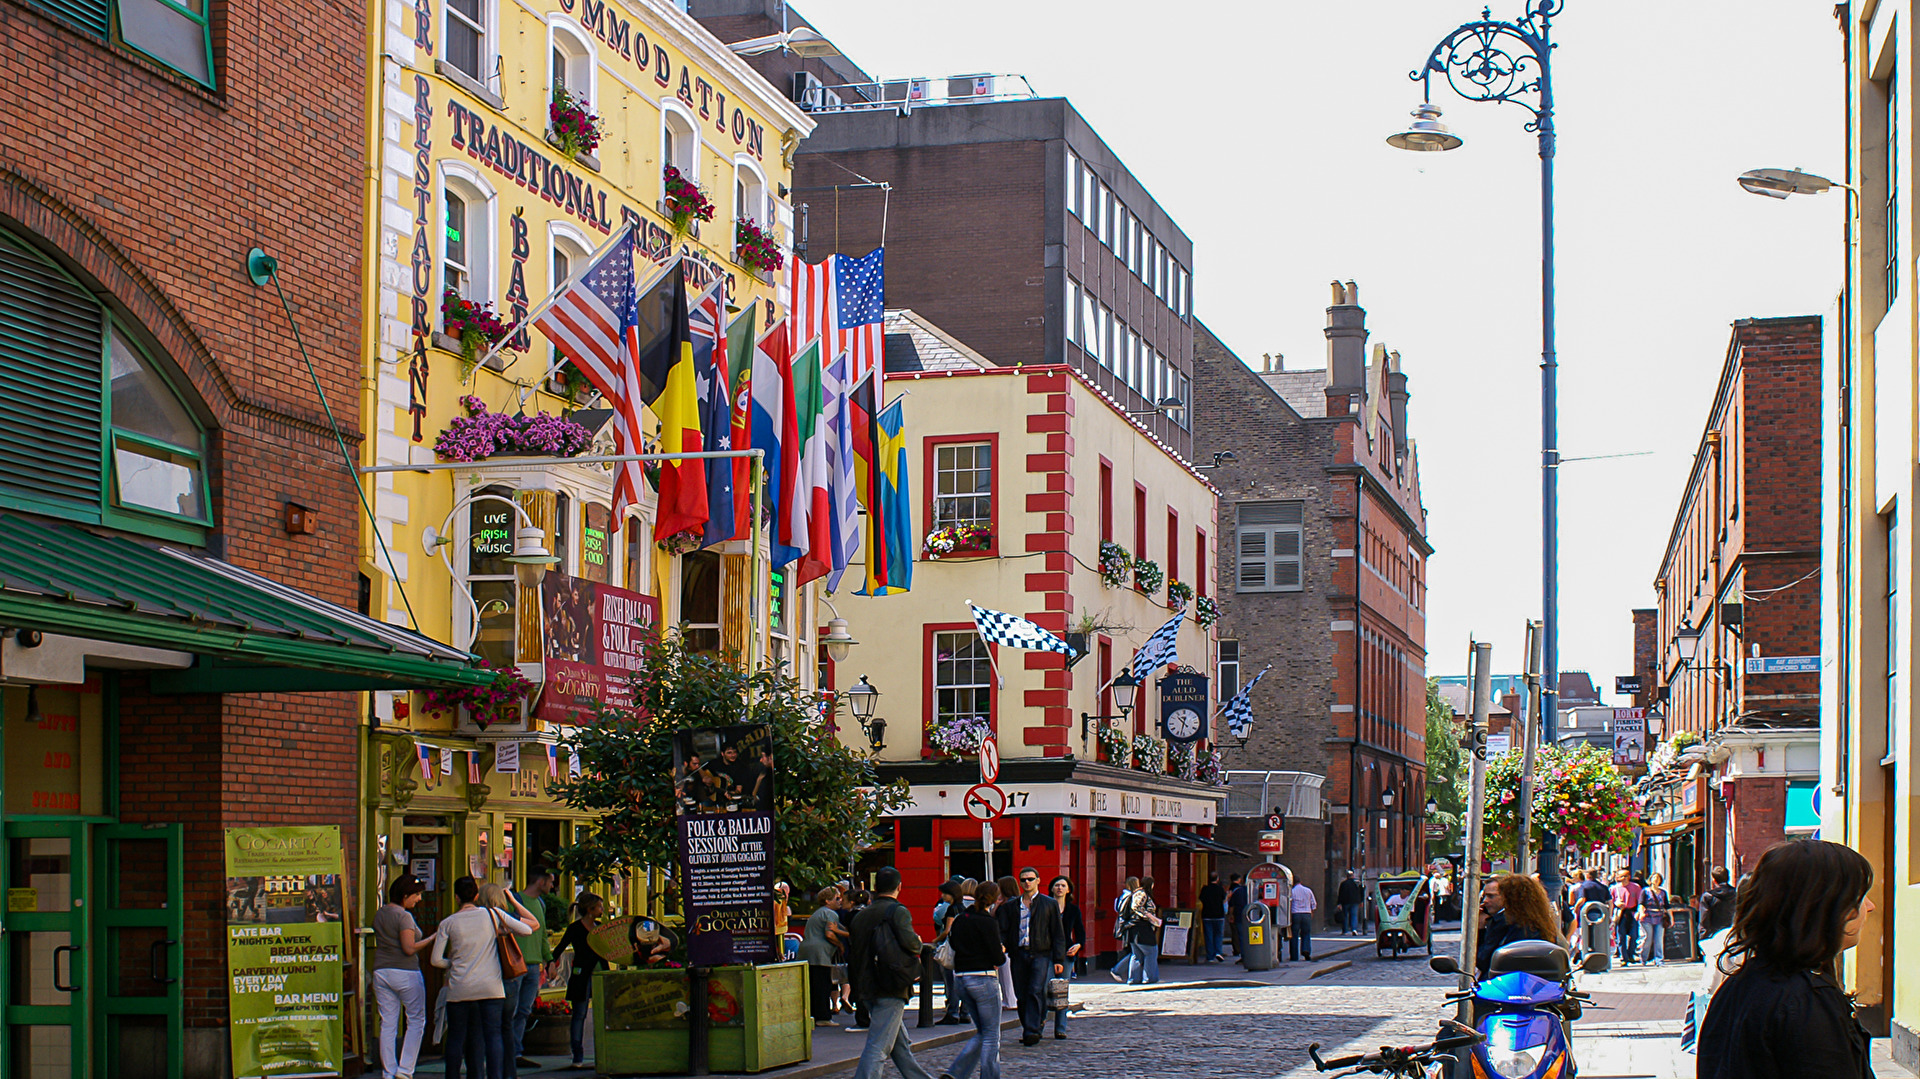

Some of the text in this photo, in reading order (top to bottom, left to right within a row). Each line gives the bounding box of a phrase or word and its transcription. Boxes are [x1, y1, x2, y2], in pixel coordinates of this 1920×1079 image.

[448, 98, 612, 236] TRADITIONAL
[682, 243, 736, 305] MUSC
[408, 73, 433, 443] RESTAURANT
[764, 195, 776, 333] BR
[506, 213, 532, 354] BAR
[484, 513, 507, 524] LIVE
[480, 529, 508, 540] IRISH
[476, 543, 511, 554] MUSIC
[602, 593, 652, 630] IRISH BALLAD
[610, 624, 631, 654] FOLK
[557, 671, 601, 698] GOGARTY
[1162, 694, 1206, 702] DUBLINER
[1615, 710, 1643, 719] RORY'S
[44, 752, 71, 768] AND
[510, 768, 538, 798] THE
[32, 791, 80, 809] STAIRS
[1007, 791, 1030, 808] 17
[1090, 790, 1108, 812] THE
[1121, 794, 1140, 814] AULD
[1152, 797, 1182, 818] DUBLINER
[687, 817, 771, 837] FOLK & BALLAD
[235, 832, 332, 851] GOGARTY'S
[688, 836, 764, 854] SESSIONS AT THE
[688, 851, 767, 864] OLIVER ST JOHN GOGARTY
[699, 914, 770, 932] GOGARTY
[231, 927, 282, 937] LATE BAR
[231, 935, 312, 946] 7 NIGHTS A WEEK
[270, 945, 338, 956] BREAKFAST
[269, 954, 339, 964] FROM 10.45 AM
[233, 965, 316, 976] CARVERY LUNCH
[233, 974, 288, 985] EVERY DAY
[234, 983, 284, 994] 12 TO 4PM
[274, 993, 339, 1005] BAR MENU
[257, 1015, 289, 1023] WEATHER
